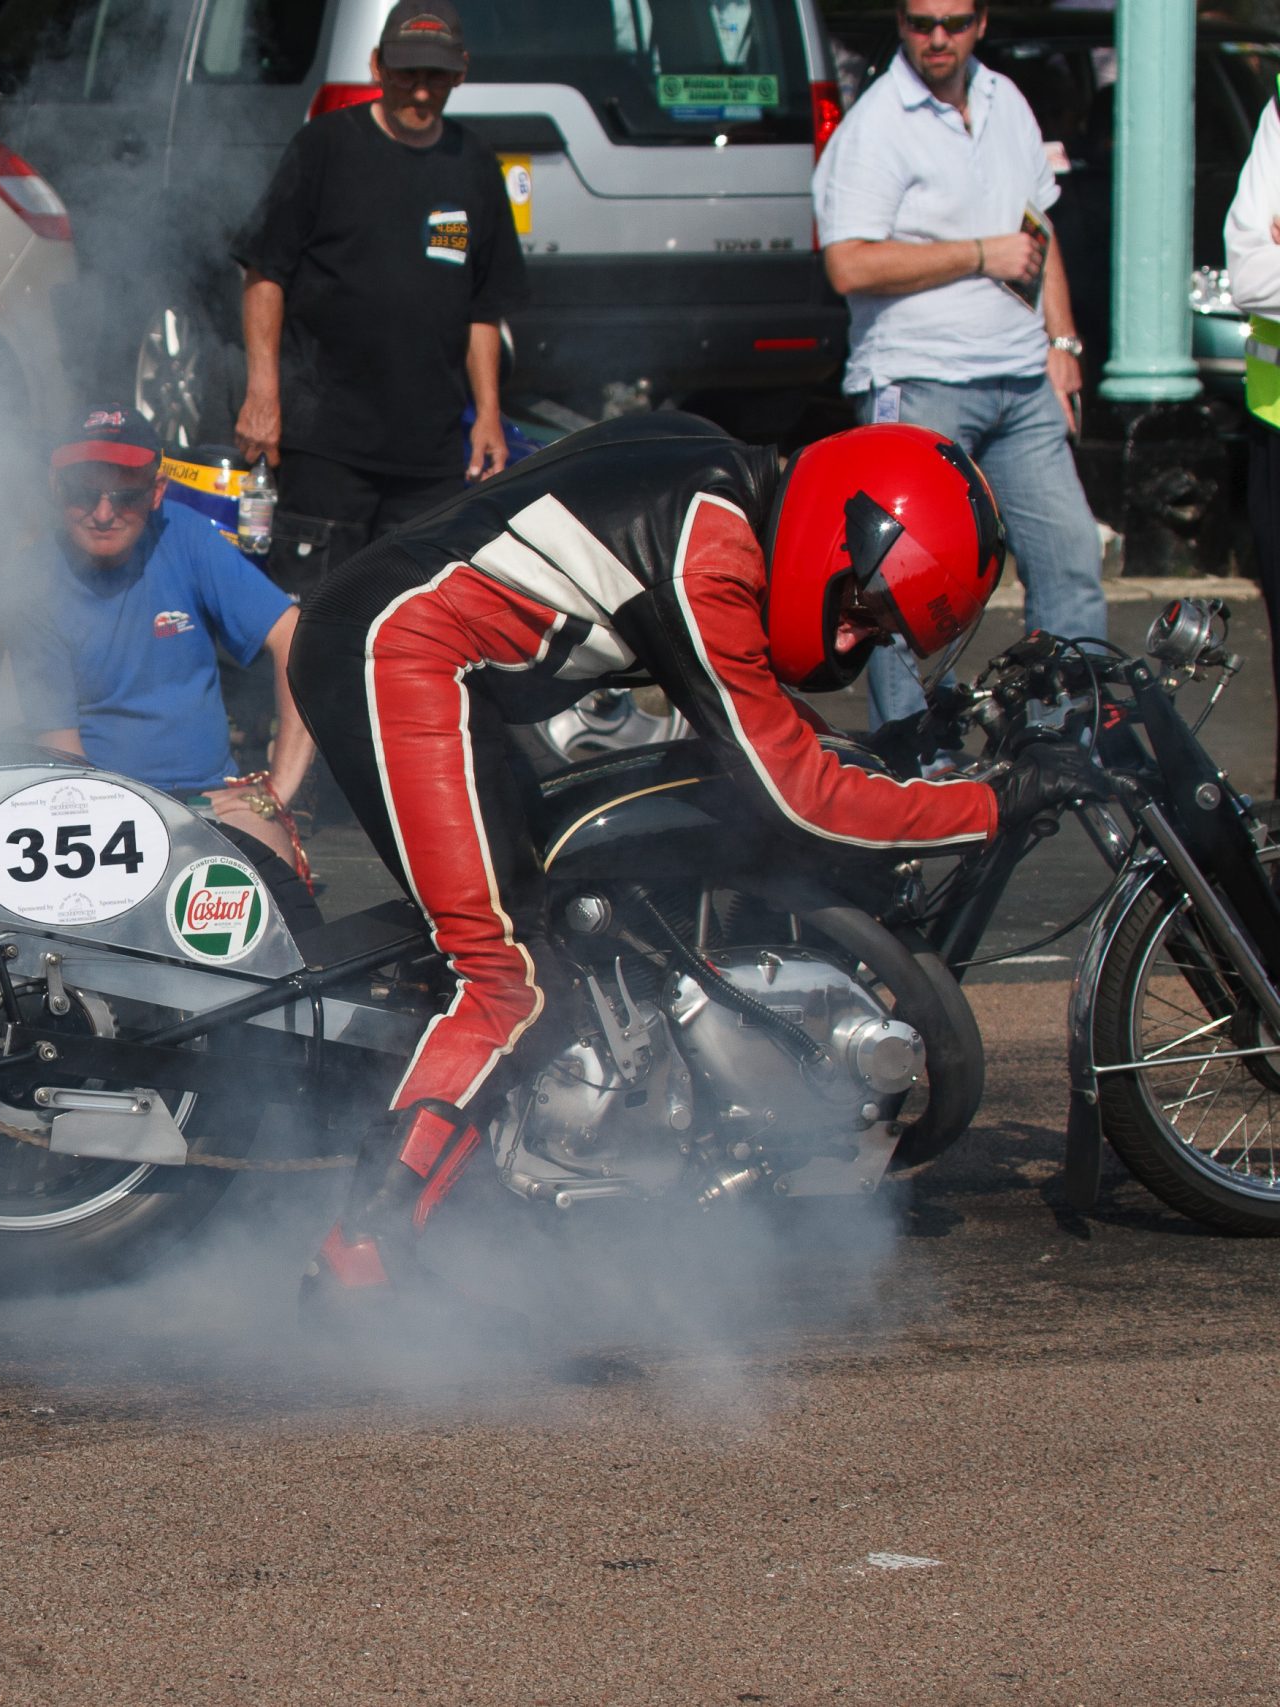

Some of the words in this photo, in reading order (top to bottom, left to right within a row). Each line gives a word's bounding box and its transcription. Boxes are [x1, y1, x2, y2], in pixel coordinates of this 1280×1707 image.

[519, 172, 528, 194] GB
[83, 411, 122, 427] 24
[6, 820, 144, 882] 354
[190, 858, 218, 871] Castrol
[220, 858, 248, 873] Classic
[249, 873, 261, 887] Oils
[187, 890, 250, 930] Castrol
